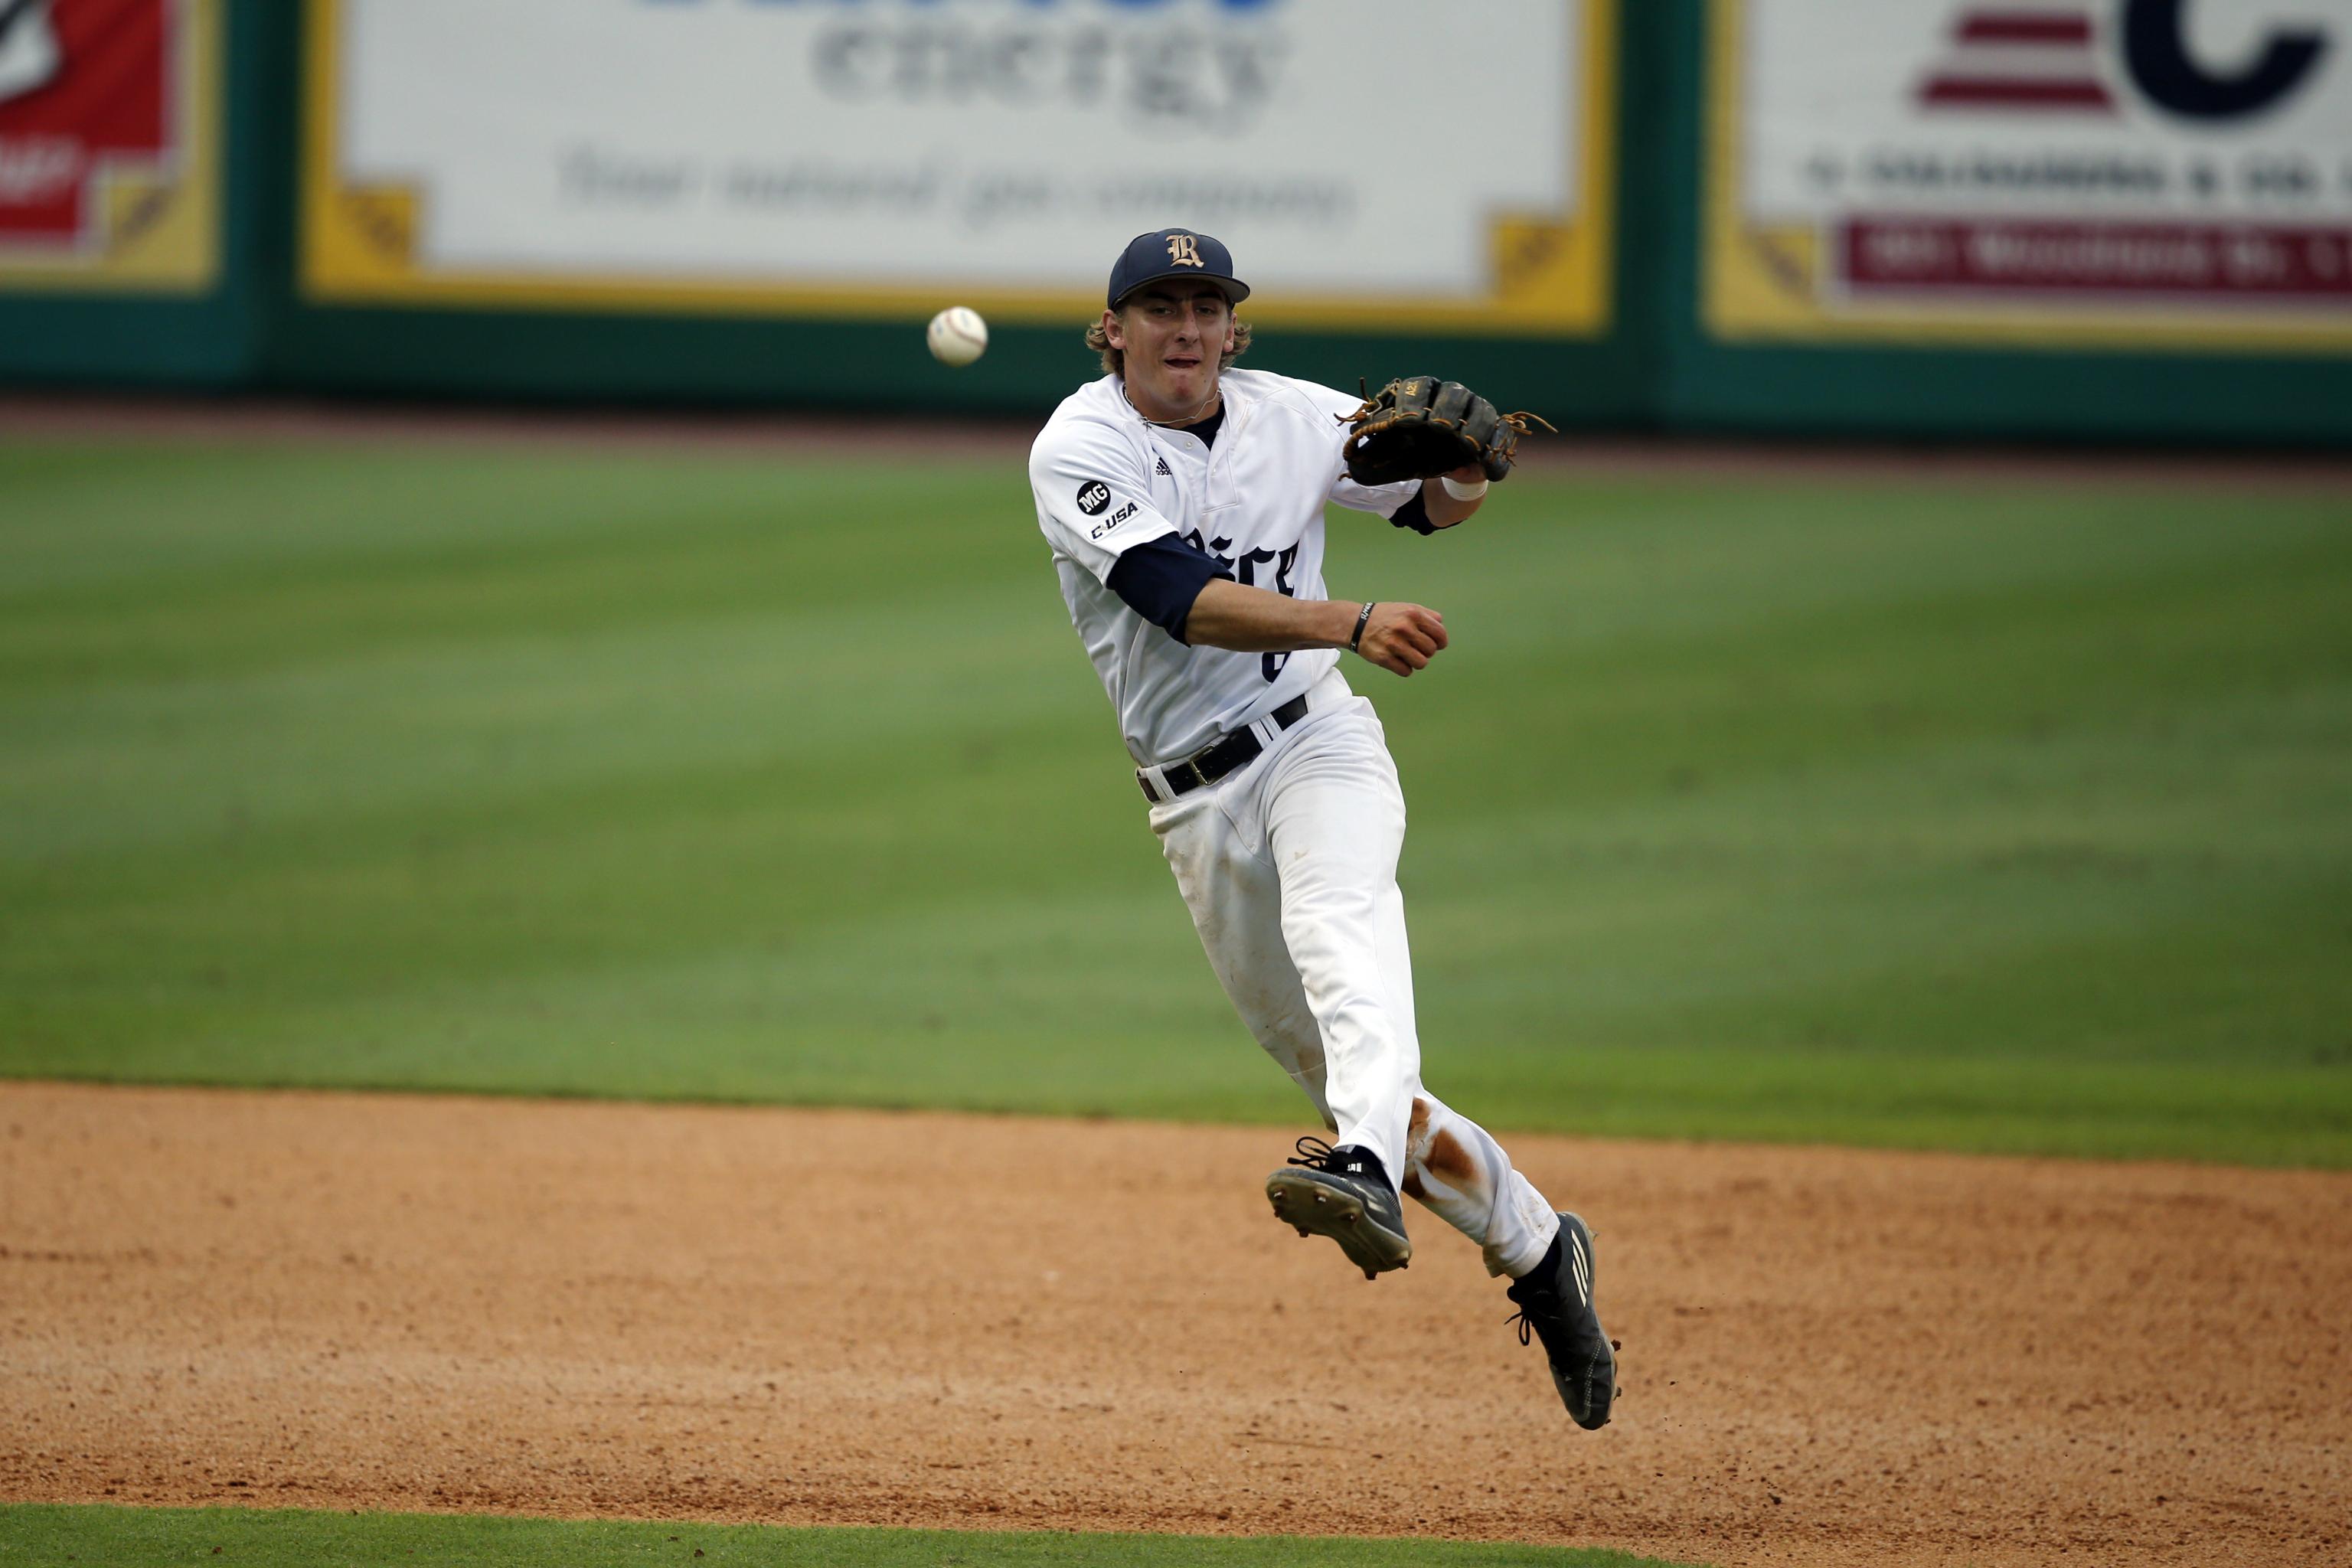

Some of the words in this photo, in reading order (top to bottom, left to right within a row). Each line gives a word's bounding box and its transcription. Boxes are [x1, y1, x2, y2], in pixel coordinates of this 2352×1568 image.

[812, 21, 1288, 130] energy
[1165, 234, 1204, 268] R
[1079, 483, 1108, 513] MG
